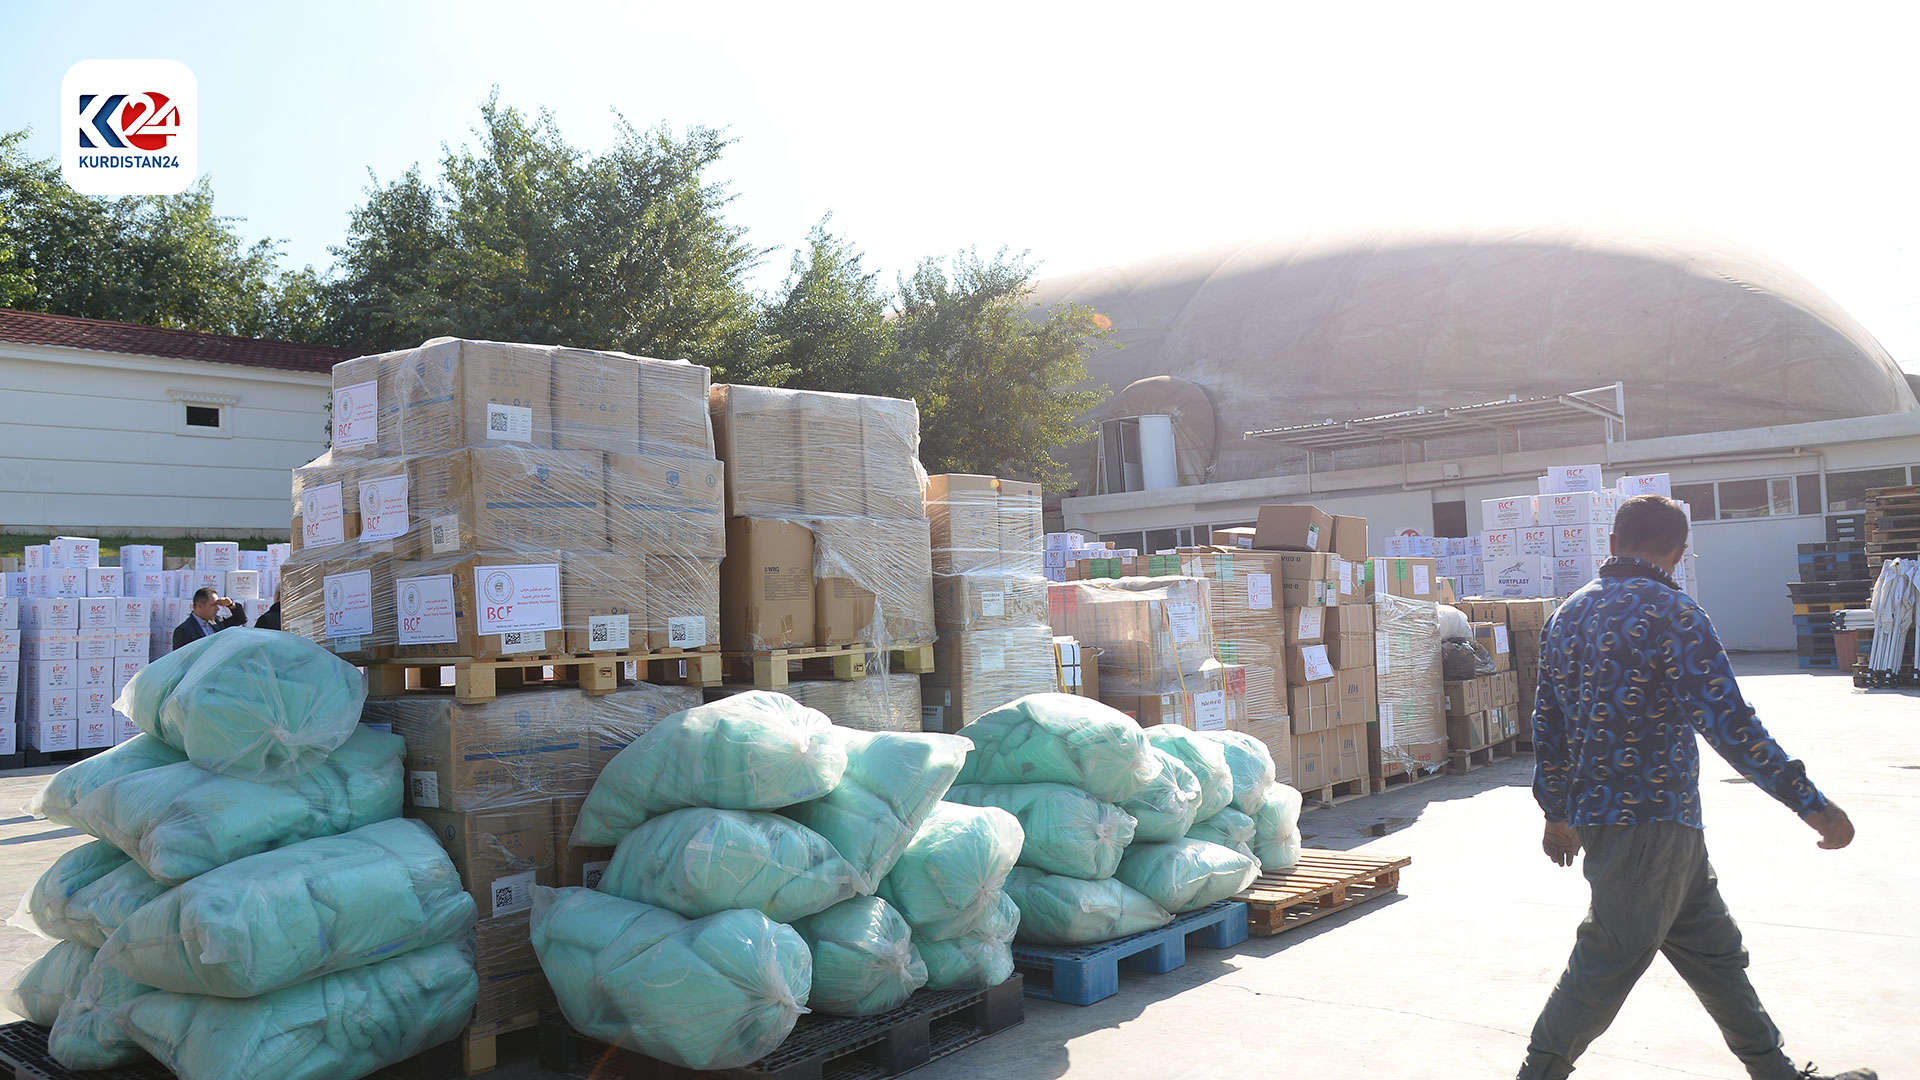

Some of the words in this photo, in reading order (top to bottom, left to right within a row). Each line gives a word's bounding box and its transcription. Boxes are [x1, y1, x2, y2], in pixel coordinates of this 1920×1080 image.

[338, 422, 352, 436] BCF
[307, 523, 318, 536] BCF
[368, 516, 380, 530] BCF
[1490, 534, 1508, 543] BCF
[1526, 532, 1544, 540] BCF
[1564, 529, 1582, 537] BCF
[330, 612, 344, 624] BCF
[487, 606, 513, 620] BCF
[404, 617, 420, 630] BCF
